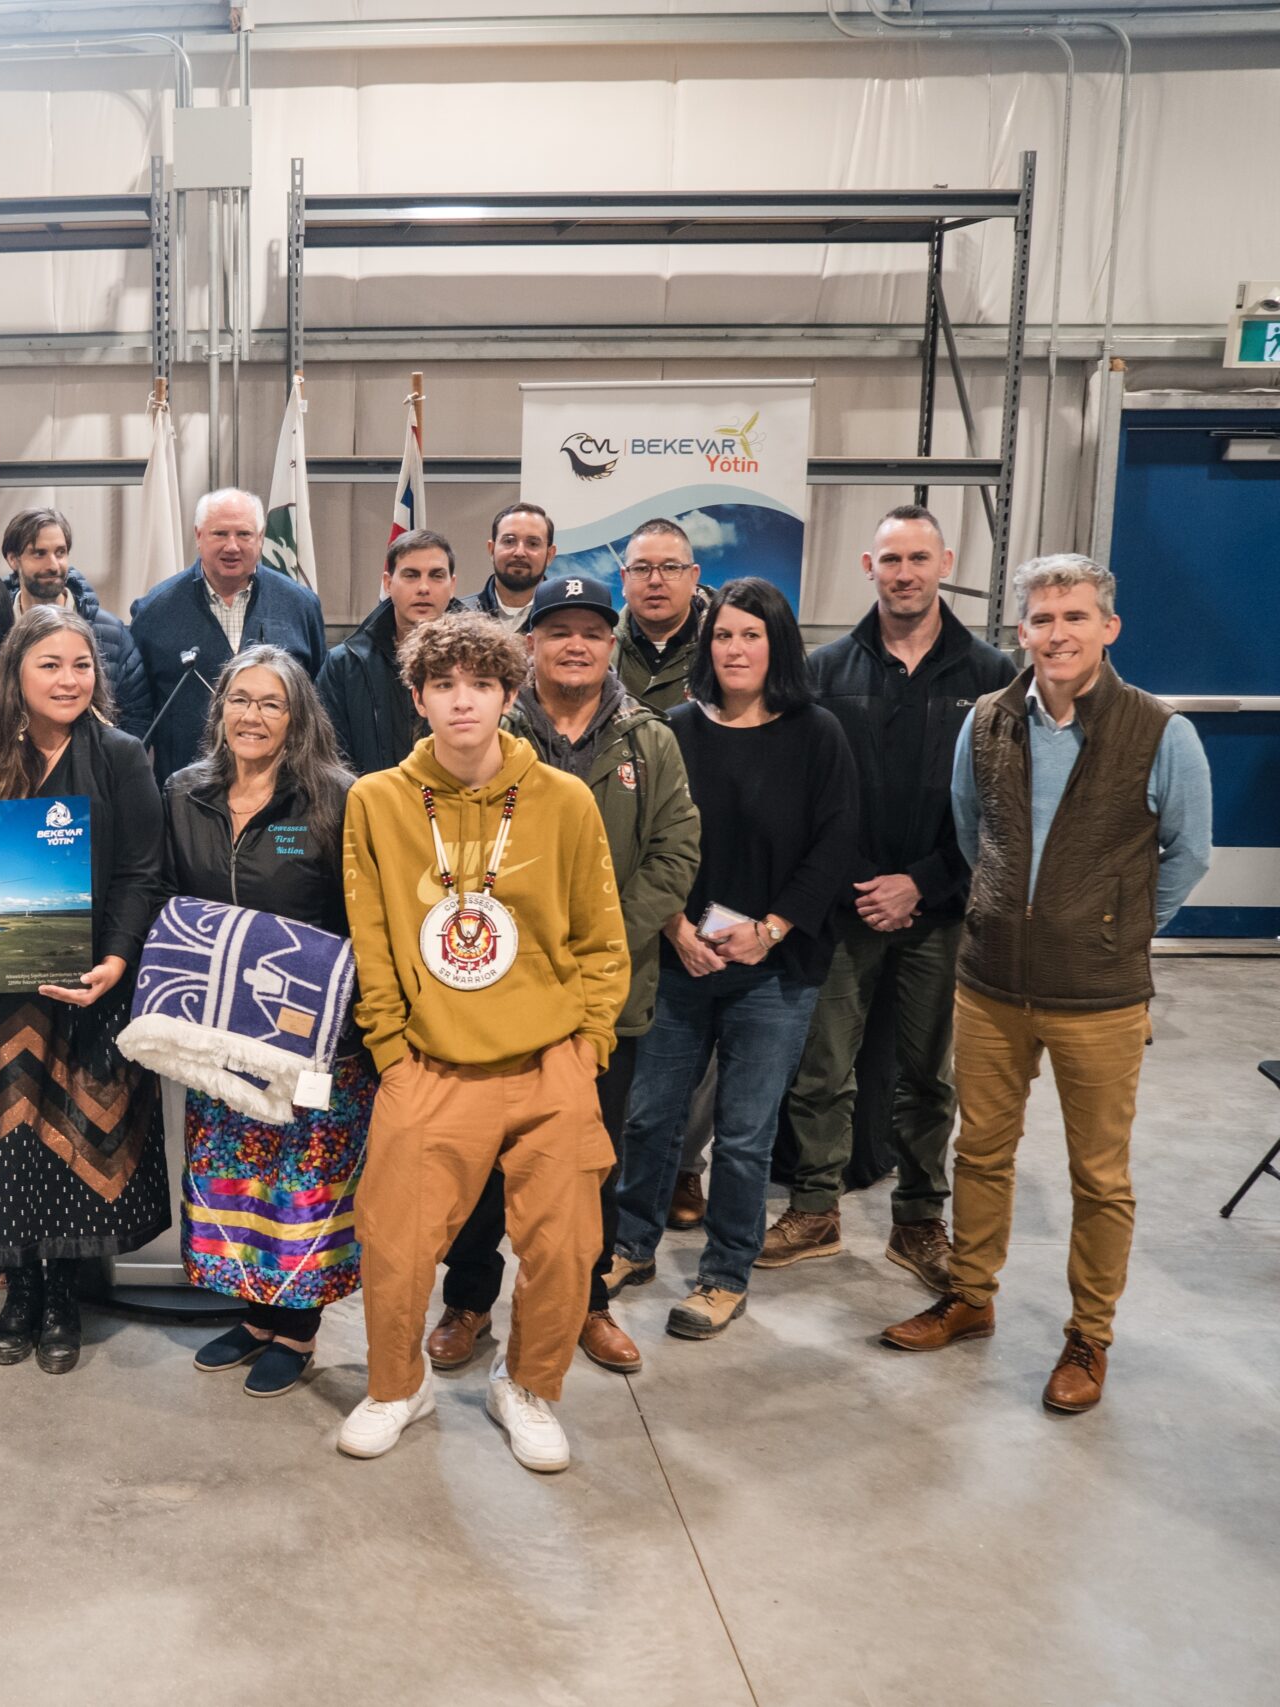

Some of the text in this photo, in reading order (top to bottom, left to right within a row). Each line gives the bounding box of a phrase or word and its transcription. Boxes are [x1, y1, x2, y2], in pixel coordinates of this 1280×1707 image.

[579, 438, 735, 455] CVL BEKEVAR
[705, 454, 759, 473] Yôtin
[565, 579, 584, 597] D
[36, 828, 84, 838] BEKEVAR
[274, 835, 295, 843] First
[276, 846, 305, 855] Nation
[443, 896, 494, 912] COESSESS
[438, 967, 498, 984] SR WARRIOR
